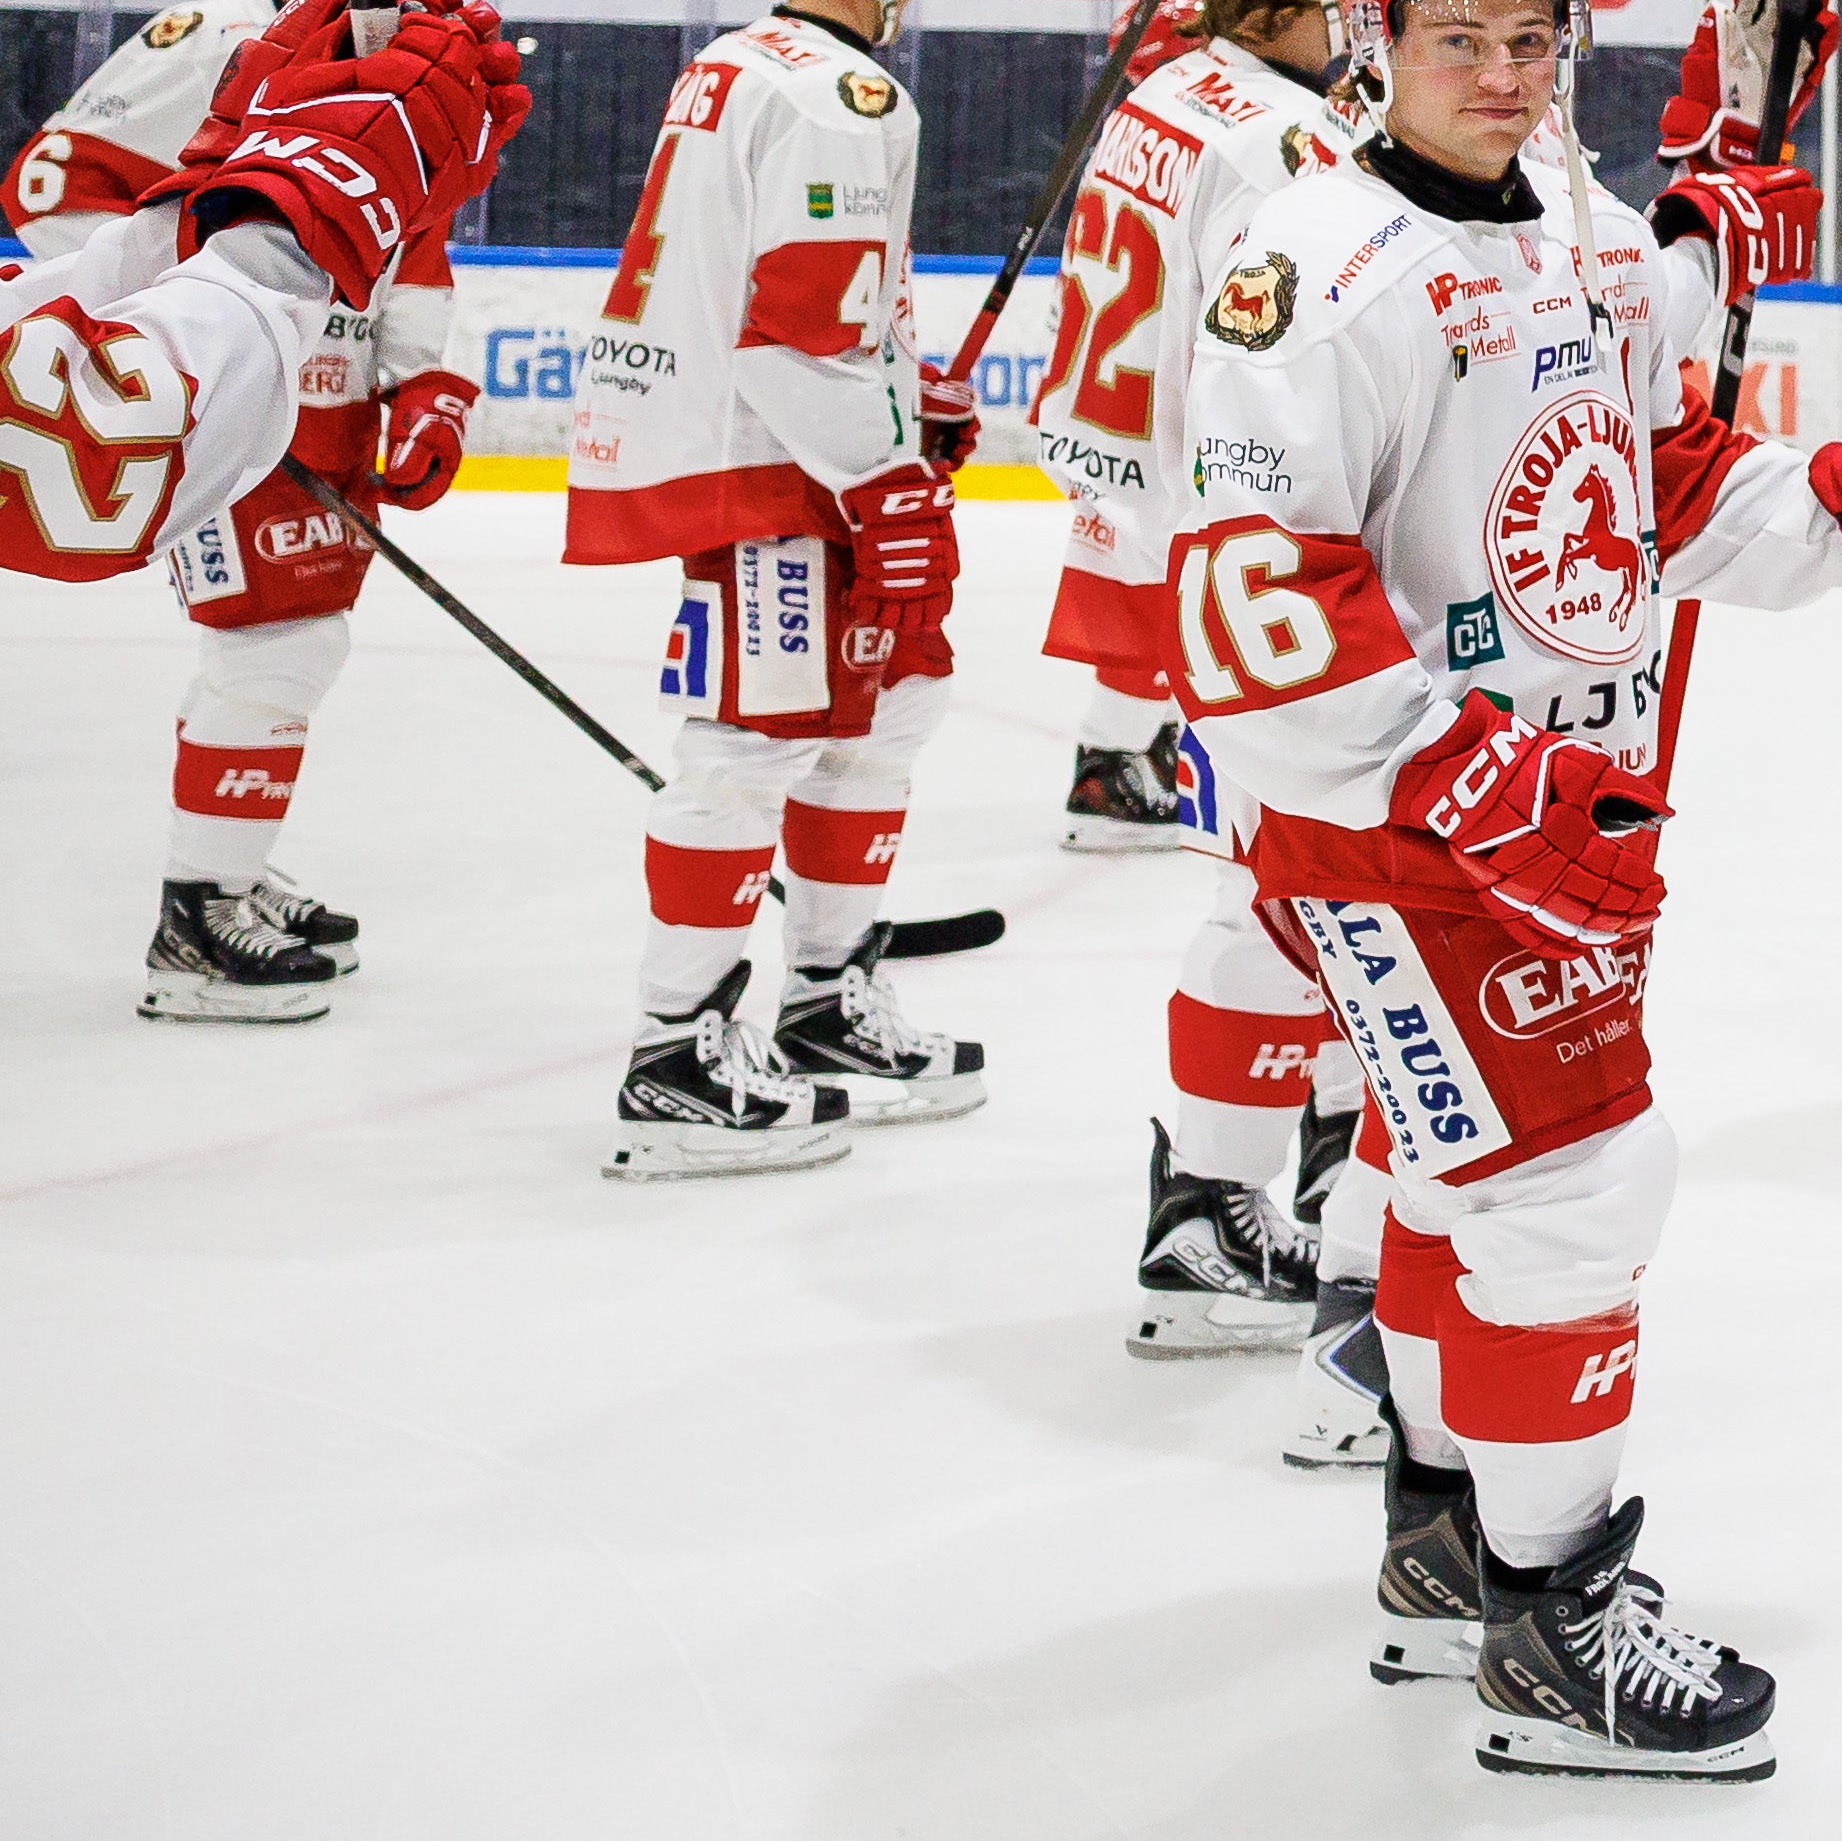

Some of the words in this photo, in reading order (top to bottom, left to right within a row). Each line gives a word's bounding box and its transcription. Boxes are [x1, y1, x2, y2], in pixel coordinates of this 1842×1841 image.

[225, 130, 401, 251] CCM
[1334, 212, 1414, 290] INTERSPORT
[1470, 325, 1517, 358] Metall
[1532, 296, 1573, 315] CCM
[591, 335, 676, 378] OYOTA
[774, 559, 811, 657] BUSS
[1177, 527, 1338, 705] 16
[1544, 590, 1603, 625] 1948
[1425, 714, 1539, 839] CCM
[1382, 1003, 1480, 1146] BUSS
[1555, 1035, 1593, 1065] Det
[1402, 1556, 1481, 1620] CCM
[1503, 1657, 1590, 1742] CCM
